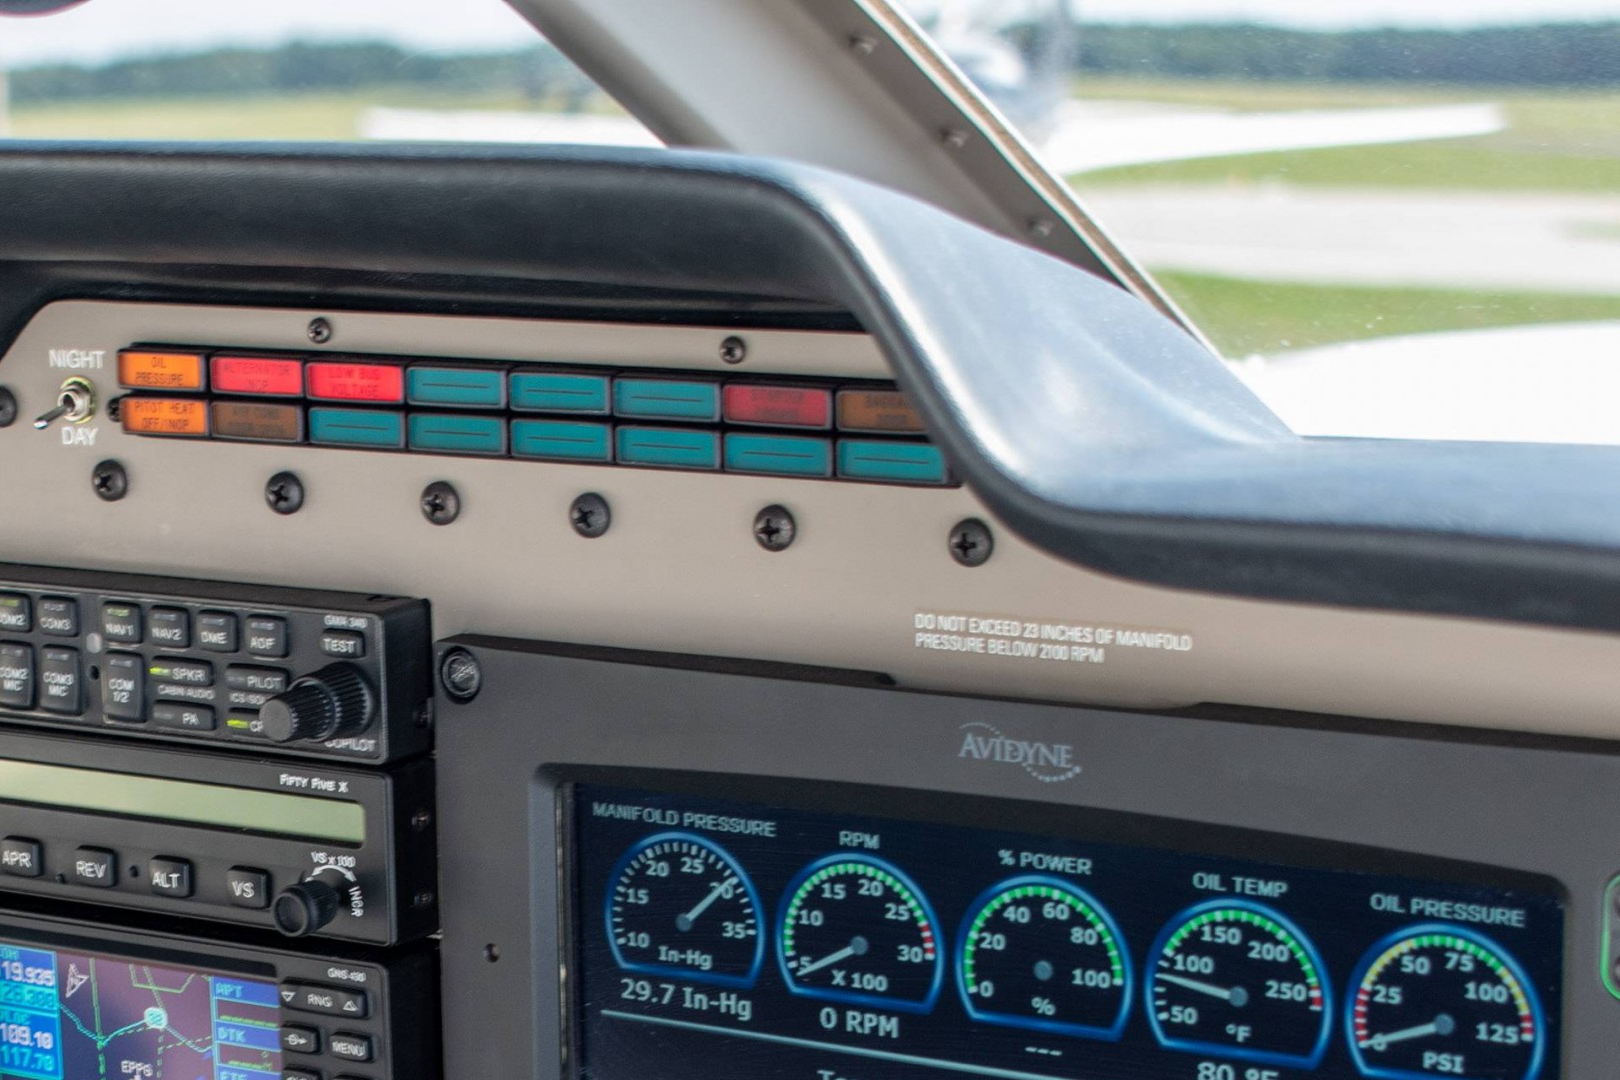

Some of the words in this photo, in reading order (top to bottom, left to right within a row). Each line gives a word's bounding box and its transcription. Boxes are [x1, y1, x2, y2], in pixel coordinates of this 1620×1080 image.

[49, 350, 105, 369] NIGHT
[136, 372, 184, 386] PRESSURE
[61, 426, 97, 444] DAY
[40, 617, 70, 630] COM3
[105, 623, 133, 636] NAV1
[914, 613, 933, 629] DO
[937, 616, 965, 632] NOT
[968, 618, 1021, 637] EXCEED
[1023, 623, 1038, 638] 23
[1040, 624, 1093, 644] INCHES
[1095, 628, 1113, 645] OF
[1115, 630, 1193, 651] MANIFOLD
[151, 627, 181, 640] NAV2
[201, 631, 227, 645] DME
[250, 637, 276, 650] ADF
[322, 639, 356, 653] TEST
[915, 633, 983, 653] PRESSURE
[988, 639, 1036, 658] BELOW
[1071, 647, 1104, 664] RPM
[43, 672, 74, 685] COM3
[172, 667, 205, 681] SPKR
[592, 802, 679, 825] MANIFOLD
[683, 813, 777, 837] PRESSURE
[839, 831, 879, 849] RPM
[2, 850, 32, 868] APR
[998, 850, 1015, 865] %
[1020, 850, 1092, 875] POWER
[76, 860, 106, 878] REV
[152, 872, 180, 889] ALT
[232, 881, 254, 898] VS
[1192, 872, 1226, 893] OIL
[1233, 876, 1287, 899] TEMP
[1370, 893, 1406, 914] OIL
[1410, 897, 1525, 928] PRESSURE
[658, 946, 713, 970] In-Hg
[831, 970, 846, 986] X
[851, 973, 888, 992] 100
[308, 993, 332, 1008] RNG
[620, 978, 675, 1006] 29.7
[683, 987, 752, 1020] In-Hg
[820, 1007, 837, 1028] 0
[845, 1011, 899, 1038] RPM
[332, 1041, 365, 1057] MENU
[1422, 1052, 1464, 1074] PSI
